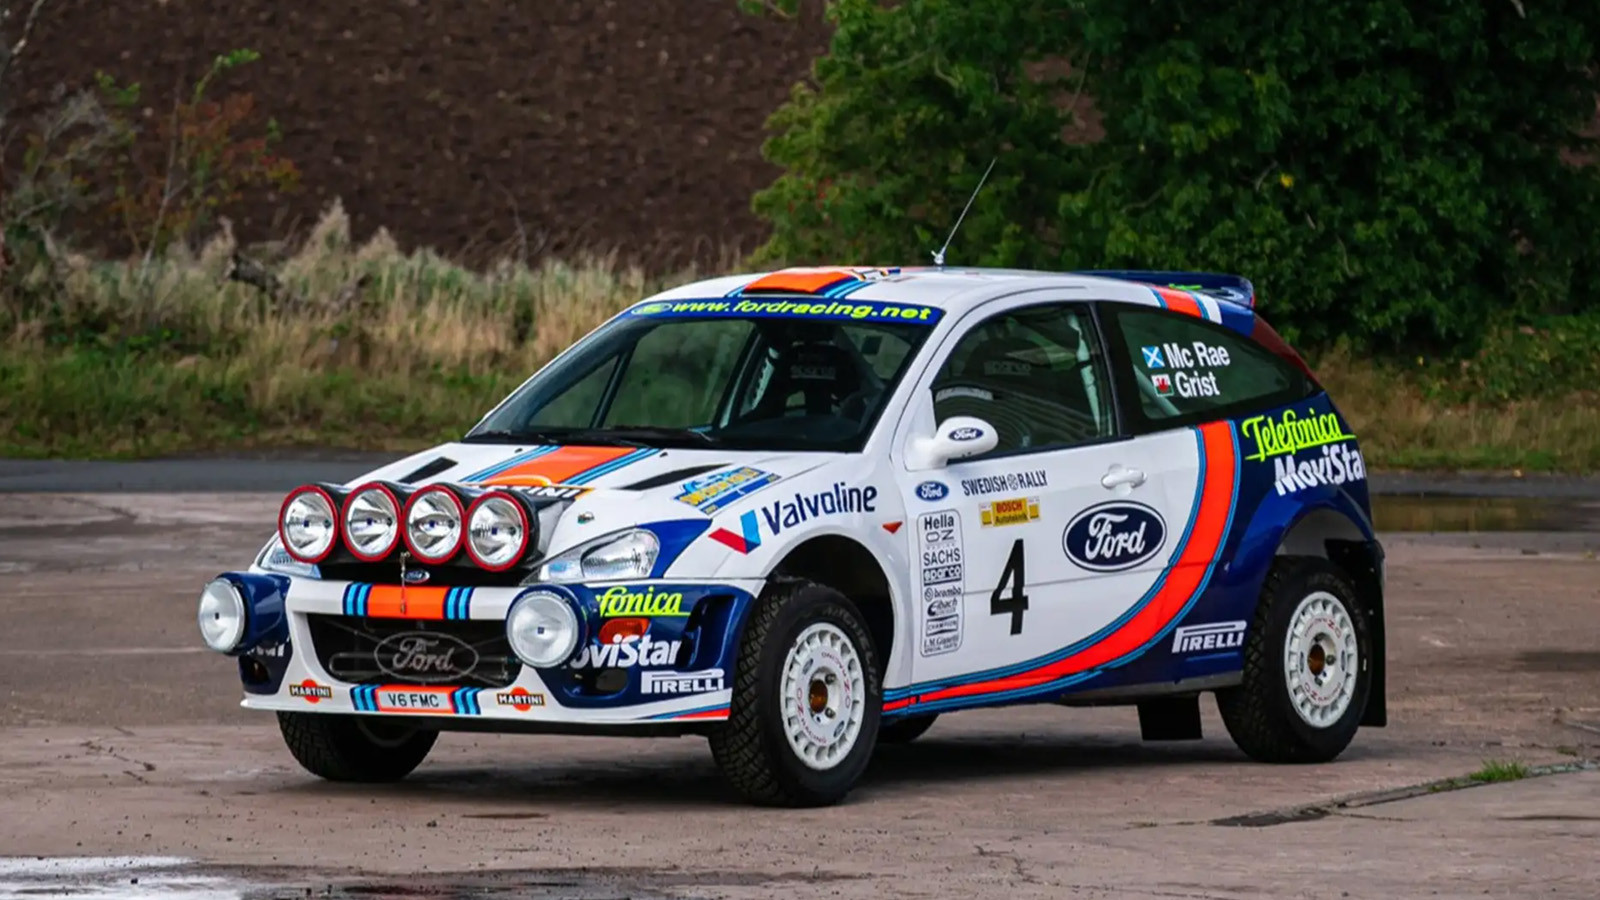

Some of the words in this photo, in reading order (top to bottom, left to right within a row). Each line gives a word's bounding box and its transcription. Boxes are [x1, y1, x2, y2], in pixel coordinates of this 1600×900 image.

[671, 300, 932, 320] www.fordracing.net
[1163, 342, 1194, 369] Mc
[1192, 341, 1231, 367] Rae
[1175, 370, 1220, 398] Grist
[953, 427, 978, 440] Ford
[921, 482, 943, 499] Ford
[961, 475, 1009, 497] SWEDISH
[1017, 469, 1048, 489] RALLY
[761, 481, 878, 536] Valvoline
[996, 500, 1023, 514] BOSCH
[924, 514, 954, 531] Hella
[1084, 512, 1147, 560] Ford
[923, 547, 961, 567] SACHS
[990, 538, 1029, 636] 4
[1171, 620, 1247, 654] PIRELLI
[392, 637, 455, 671] Ford
[290, 686, 331, 699] MARTINI
[641, 668, 725, 694] PIRELLI
[388, 692, 407, 707] V6
[410, 693, 440, 708] FMC
[499, 694, 543, 706] MARTINI
